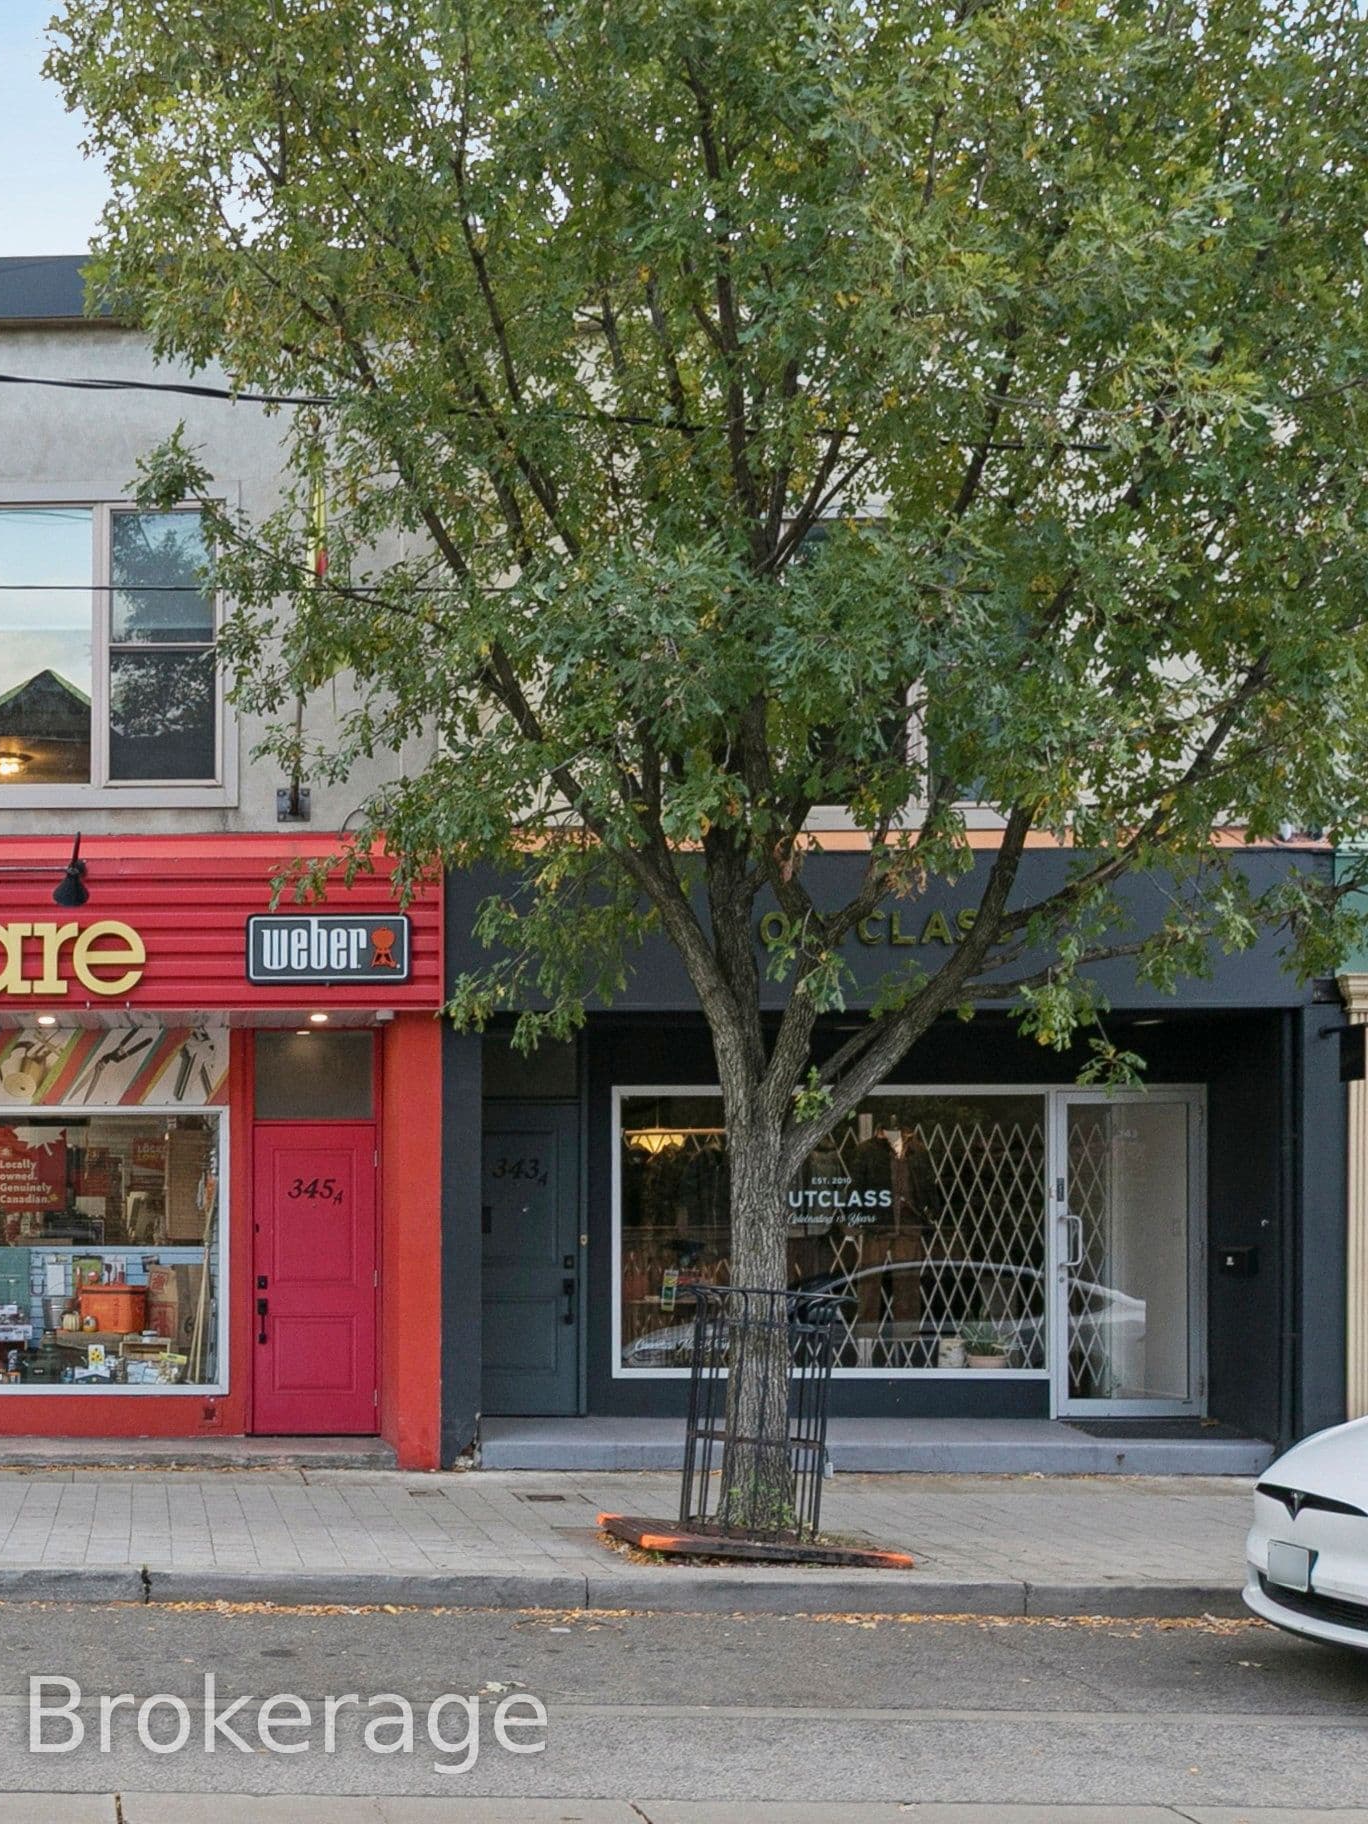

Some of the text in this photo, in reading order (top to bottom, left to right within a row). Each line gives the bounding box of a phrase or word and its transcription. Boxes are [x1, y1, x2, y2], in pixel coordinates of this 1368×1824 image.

[261, 917, 368, 970] weber
[0, 1159, 37, 1171] Locally
[0, 1173, 38, 1181] owned.
[0, 1182, 52, 1194] Genuinely
[0, 1194, 50, 1204] Canadian.
[788, 1189, 892, 1208] UTCLASS
